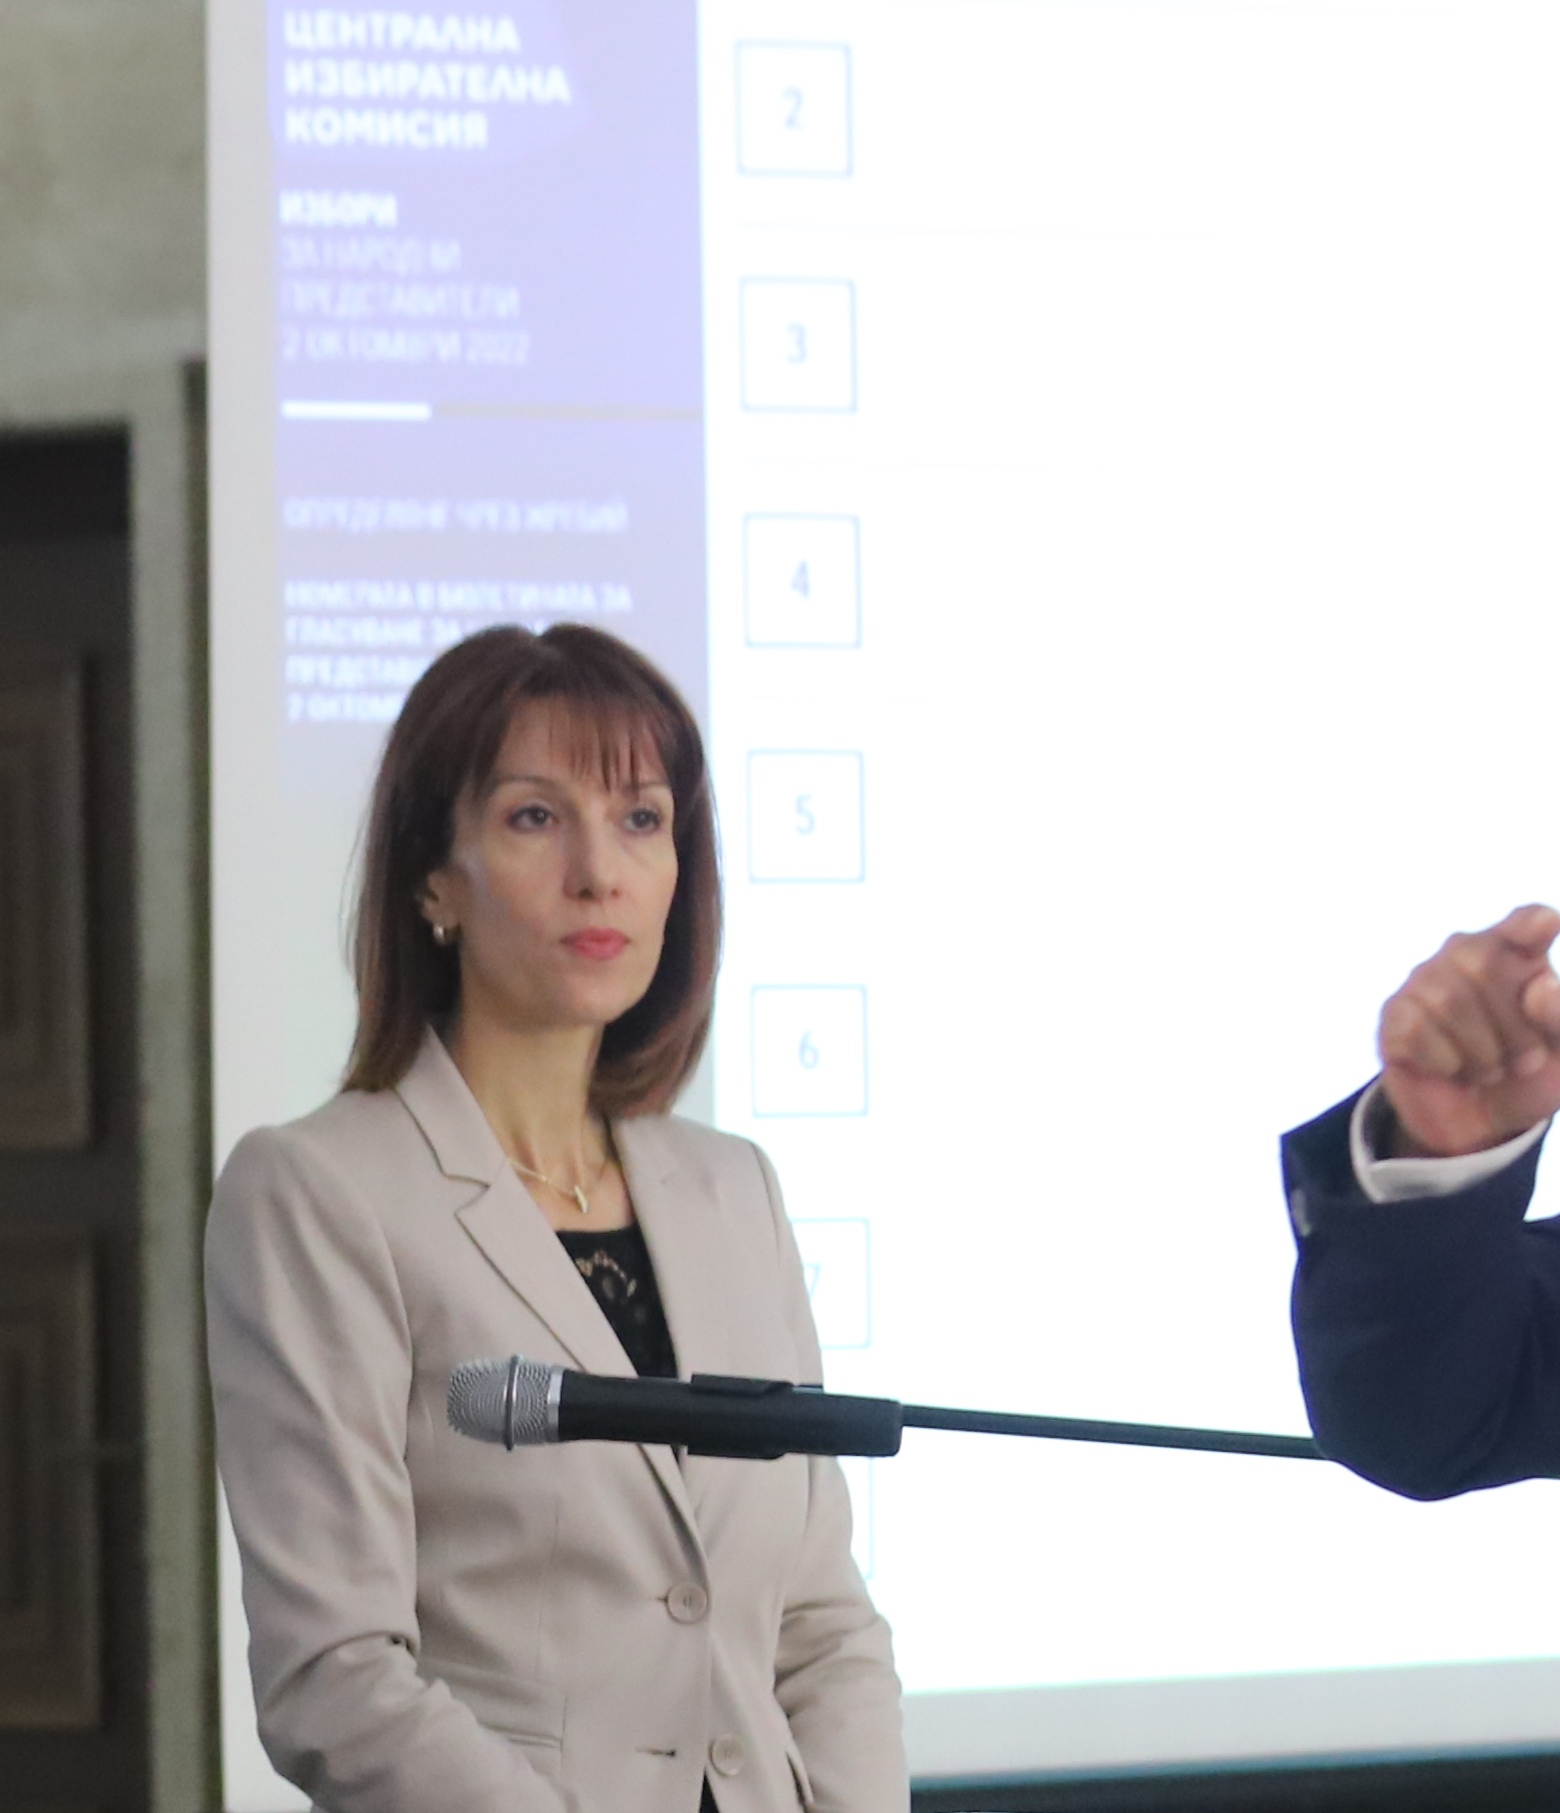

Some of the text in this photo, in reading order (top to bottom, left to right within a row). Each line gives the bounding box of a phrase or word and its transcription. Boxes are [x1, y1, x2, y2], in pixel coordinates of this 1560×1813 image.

[283, 10, 521, 53] ЦЕНТРАЛНА
[283, 58, 571, 104] ИЗБИРАТЕЛНА
[284, 107, 489, 150] КОМИСИЯ
[782, 85, 804, 130] 2
[786, 322, 808, 365] 3
[790, 558, 812, 599] 4
[795, 793, 816, 835] 5
[798, 1029, 820, 1070] 6
